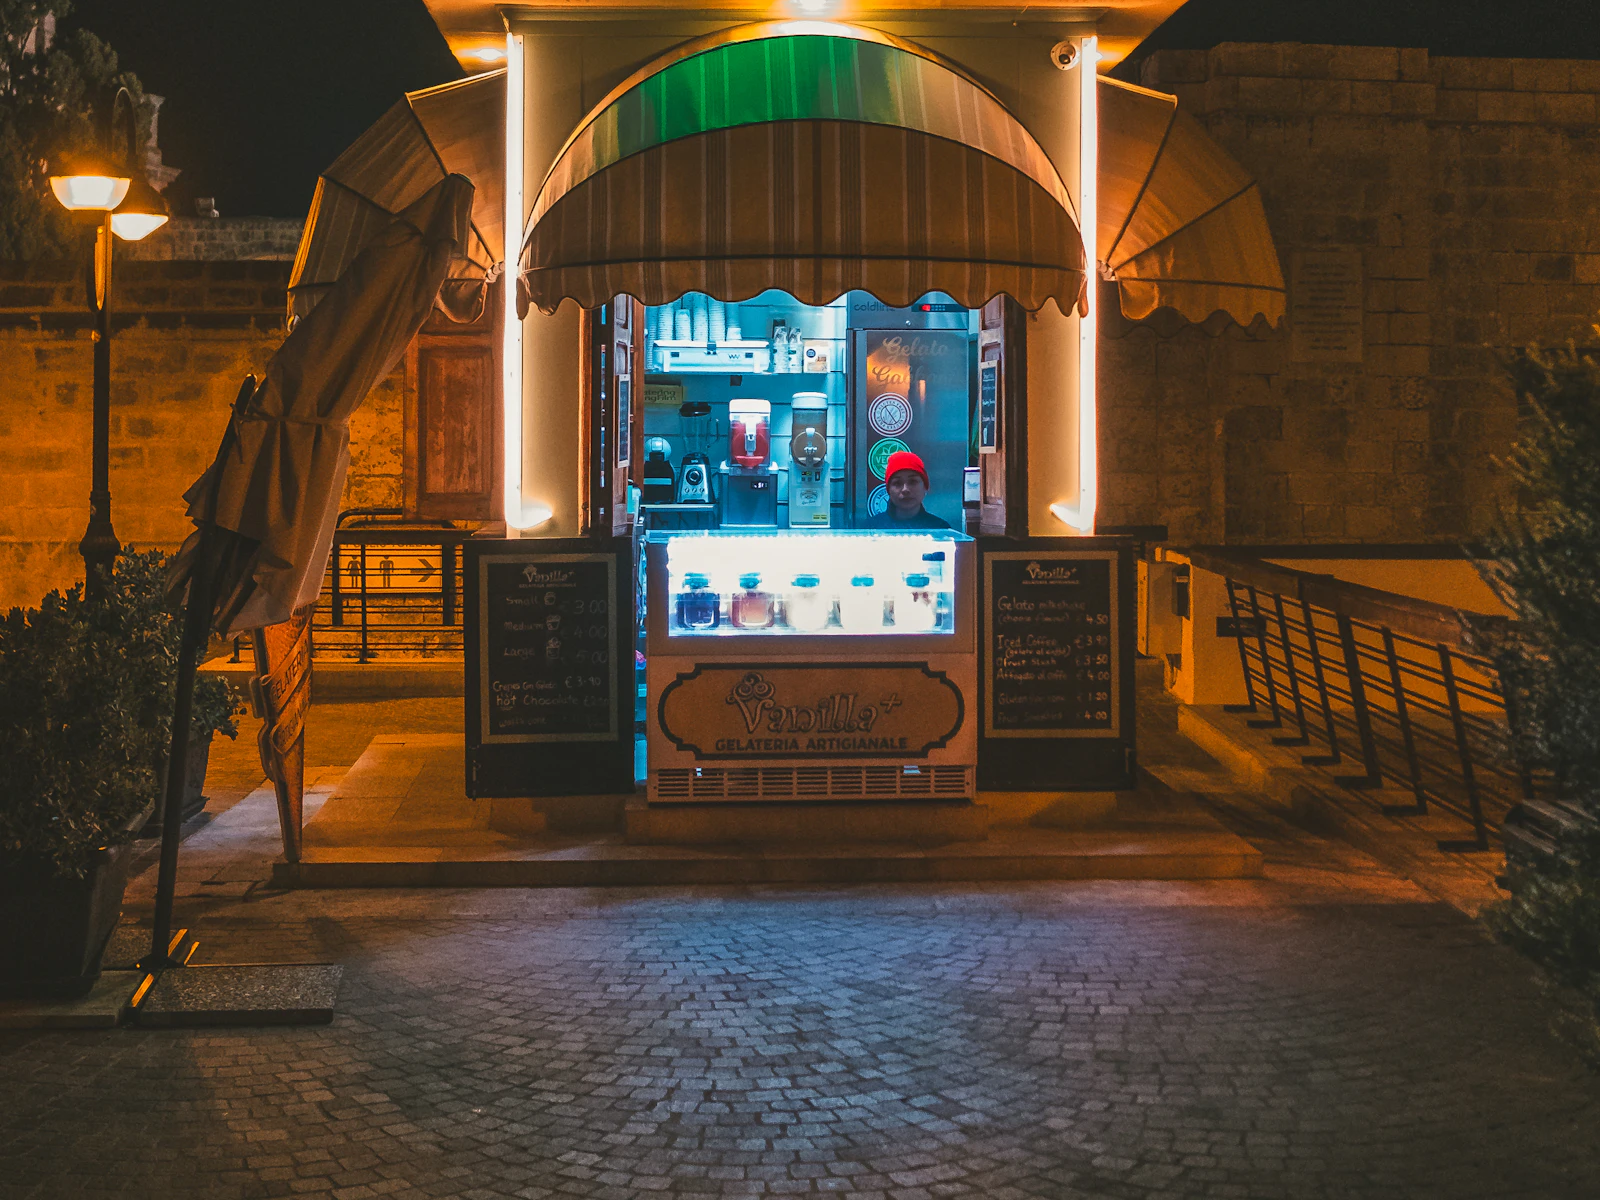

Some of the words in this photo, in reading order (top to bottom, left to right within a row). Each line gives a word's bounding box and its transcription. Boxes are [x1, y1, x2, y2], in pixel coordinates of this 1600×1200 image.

[883, 336, 948, 363] Gelato
[997, 595, 1035, 611] Gelato
[715, 738, 799, 751] GELATERIA
[806, 736, 908, 750] ARTIGIANALE
